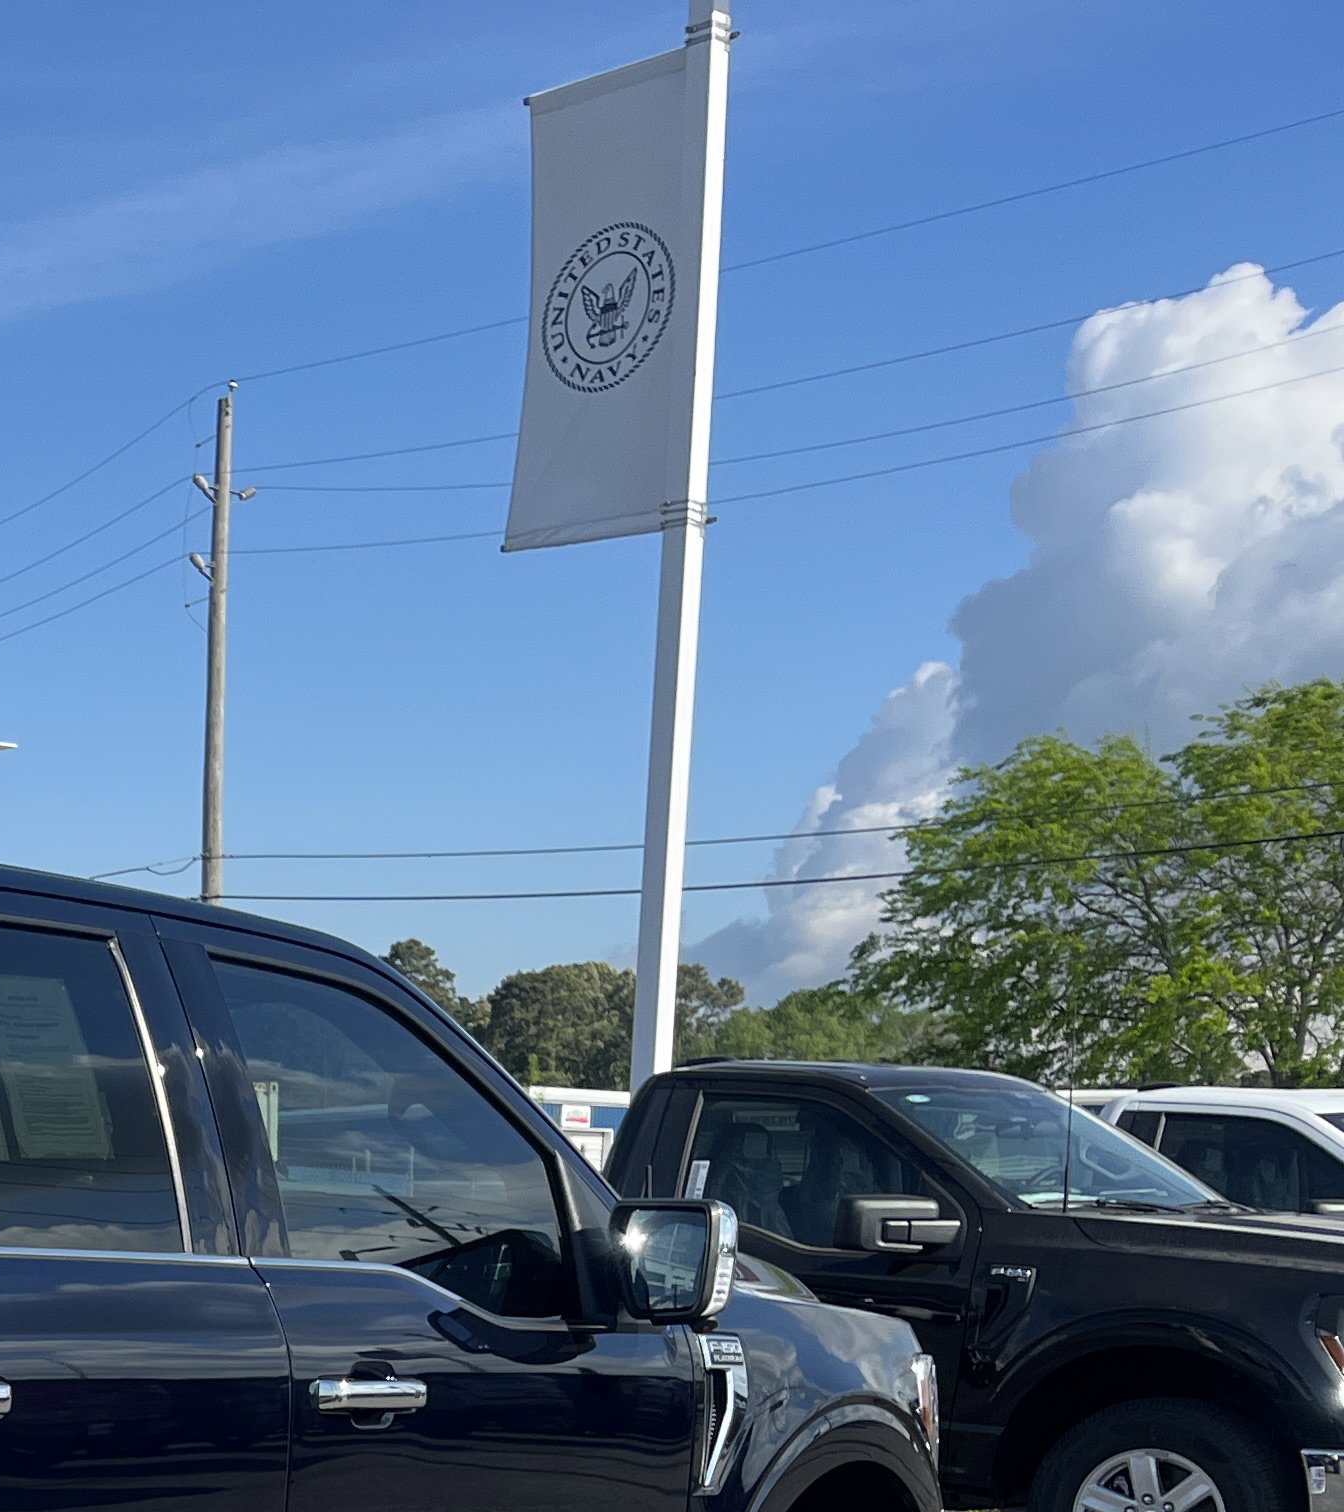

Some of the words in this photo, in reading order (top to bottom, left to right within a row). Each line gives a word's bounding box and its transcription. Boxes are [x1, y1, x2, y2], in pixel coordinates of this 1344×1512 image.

[551, 236, 612, 351] UNITED
[618, 231, 665, 325] STATES
[570, 343, 638, 385] NAVY
